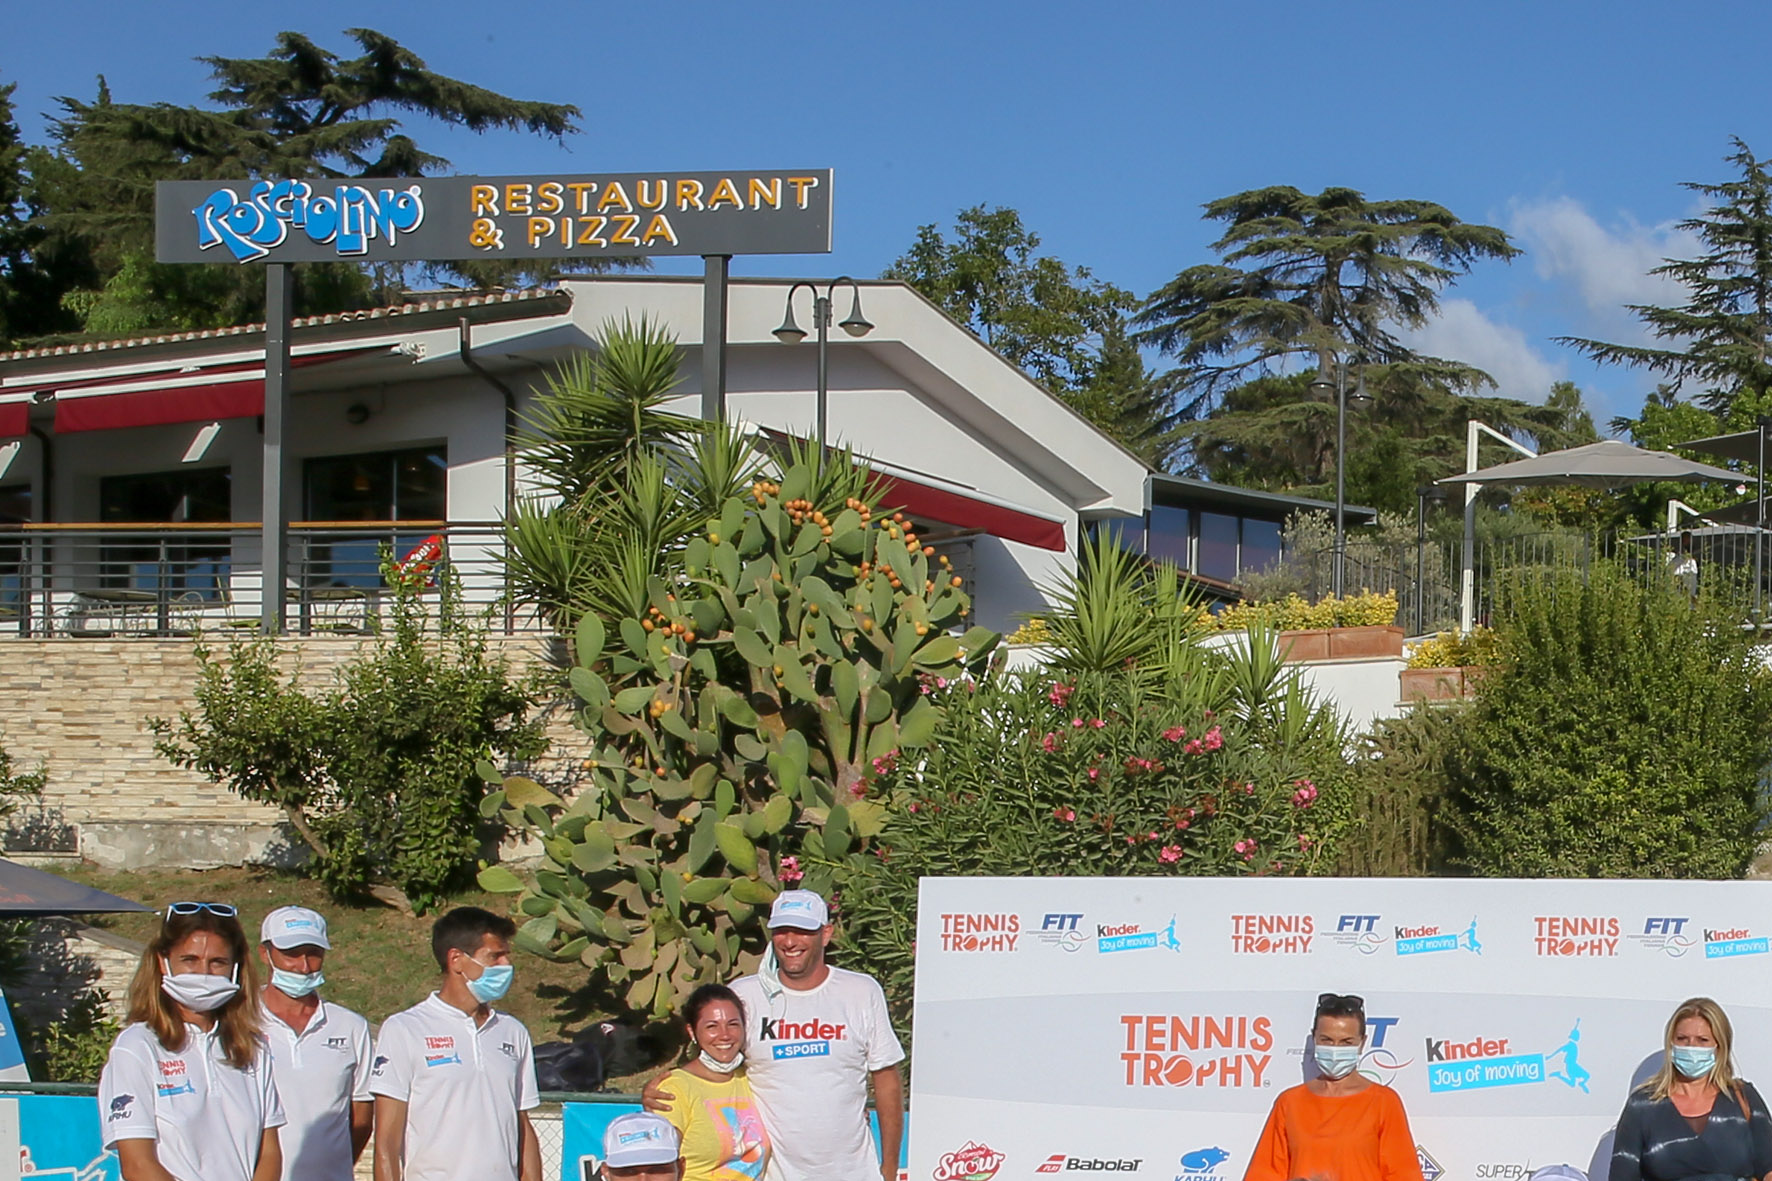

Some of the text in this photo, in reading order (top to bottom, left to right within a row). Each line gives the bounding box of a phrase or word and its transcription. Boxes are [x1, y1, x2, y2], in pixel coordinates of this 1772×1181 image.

[469, 176, 820, 216] RESTAURANT
[468, 214, 679, 250] & PIZZA
[941, 914, 1019, 932] TENNIS
[1041, 914, 1084, 930] FIT
[1231, 915, 1313, 934] TENNIS
[1337, 915, 1381, 931] FIT
[1534, 917, 1619, 936] TENNIS
[1644, 918, 1689, 934] FIT
[941, 934, 1018, 952] TROPHY
[1101, 934, 1155, 951] Joy of moving
[1231, 936, 1312, 953] TROPHY
[1399, 936, 1455, 953] Joy of moving
[1535, 938, 1618, 956] TROPHY
[1708, 940, 1766, 955] Joy of moving
[425, 1036, 454, 1044] TENNIS
[1121, 1015, 1273, 1051] TENNIS
[1121, 1053, 1272, 1087] TROPHY
[1433, 1060, 1540, 1087] Joy of moving
[934, 1154, 1005, 1180] Snow
[1475, 1164, 1522, 1179] SUPER
